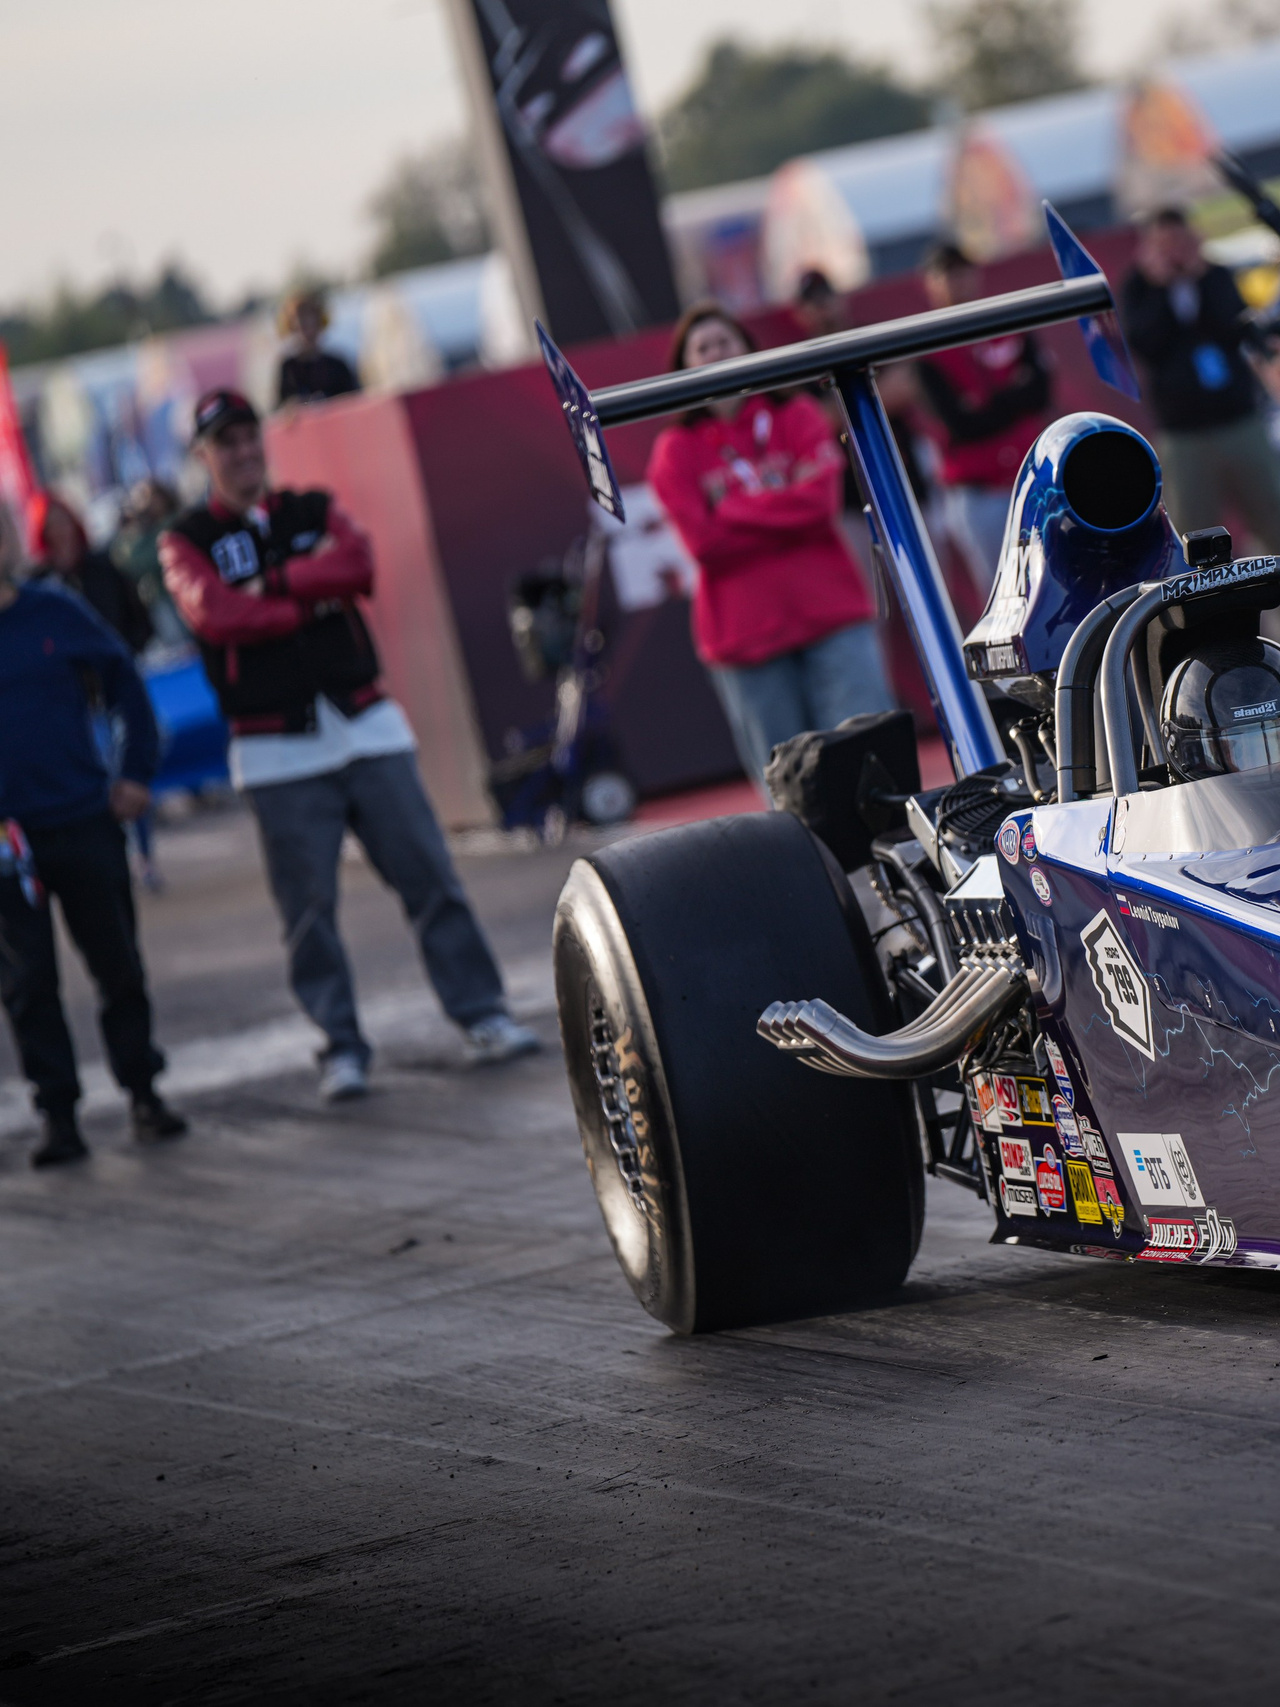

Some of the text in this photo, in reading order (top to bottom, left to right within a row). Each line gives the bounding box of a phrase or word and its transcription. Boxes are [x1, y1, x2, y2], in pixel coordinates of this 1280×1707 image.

[1233, 702, 1277, 718] stand21
[1128, 901, 1180, 930] Leonid Tsygankov
[1105, 963, 1139, 1005] 799
[993, 1076, 1018, 1110] MSD
[1143, 1157, 1171, 1190] ВТБ
[1008, 1187, 1038, 1204] MOSER
[1148, 1223, 1196, 1249] HUGHES
[1140, 1249, 1189, 1260] CONVERTERS
